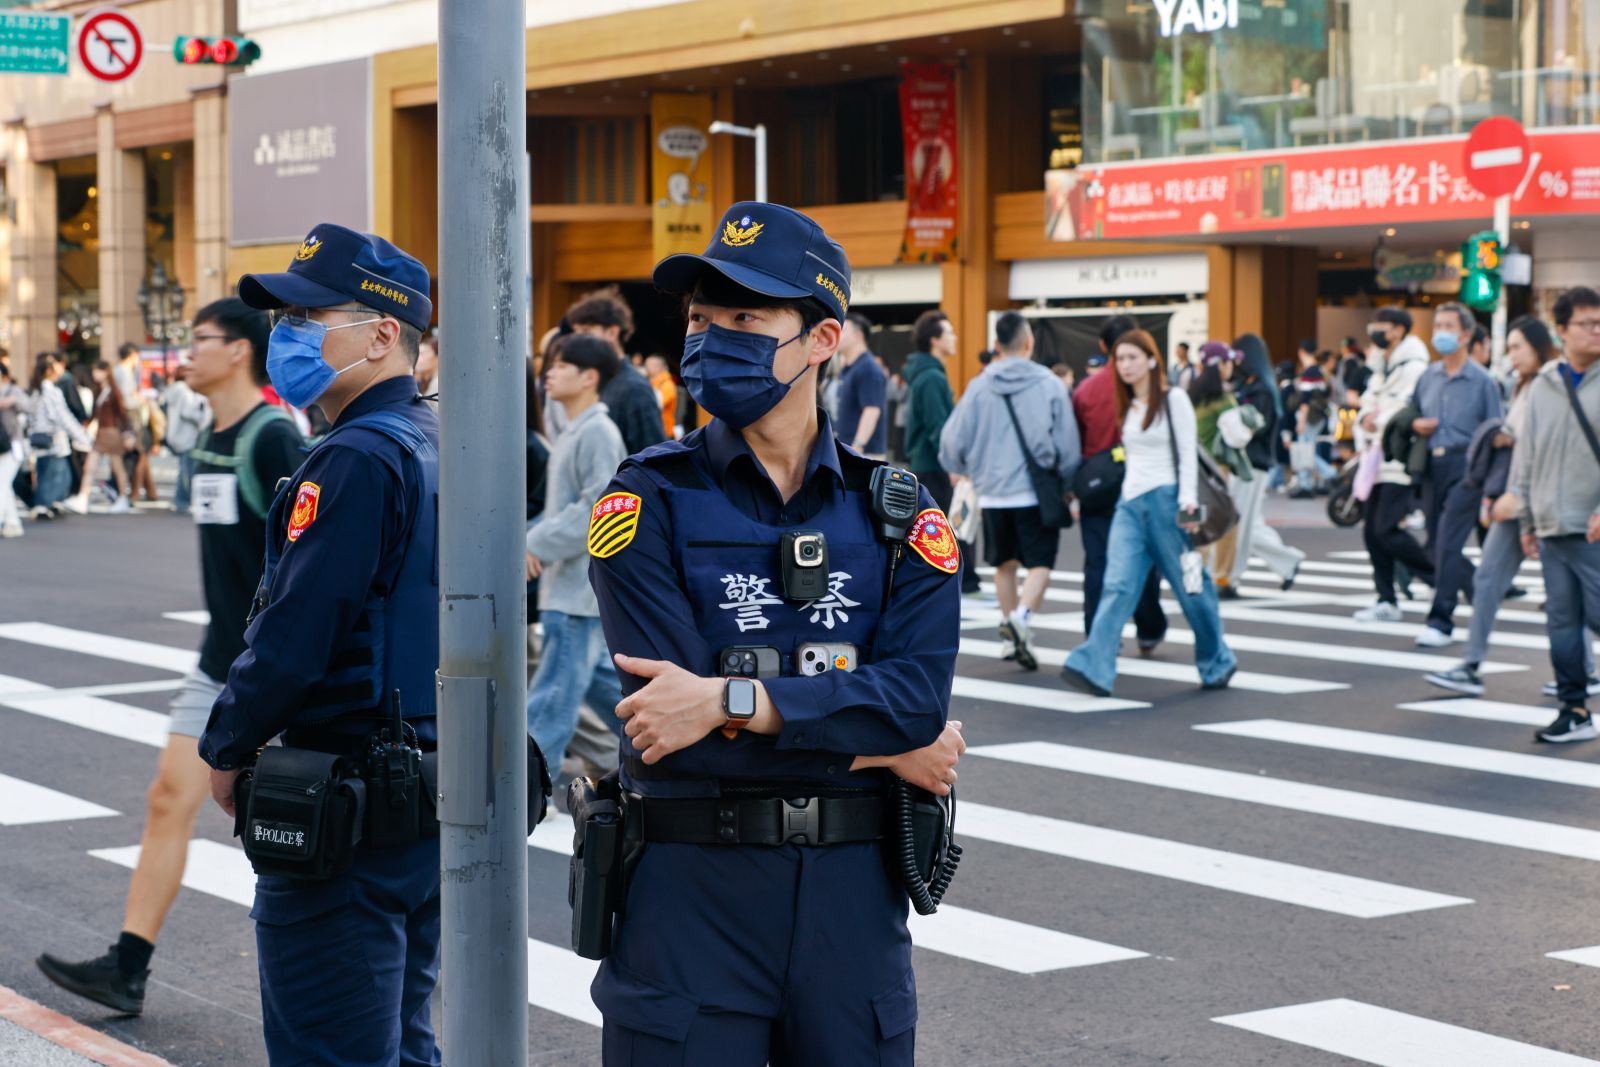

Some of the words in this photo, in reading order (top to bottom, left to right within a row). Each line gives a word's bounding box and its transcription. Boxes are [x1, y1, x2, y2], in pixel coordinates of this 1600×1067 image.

[595, 496, 636, 518] 交通警察
[836, 658, 847, 667] 30
